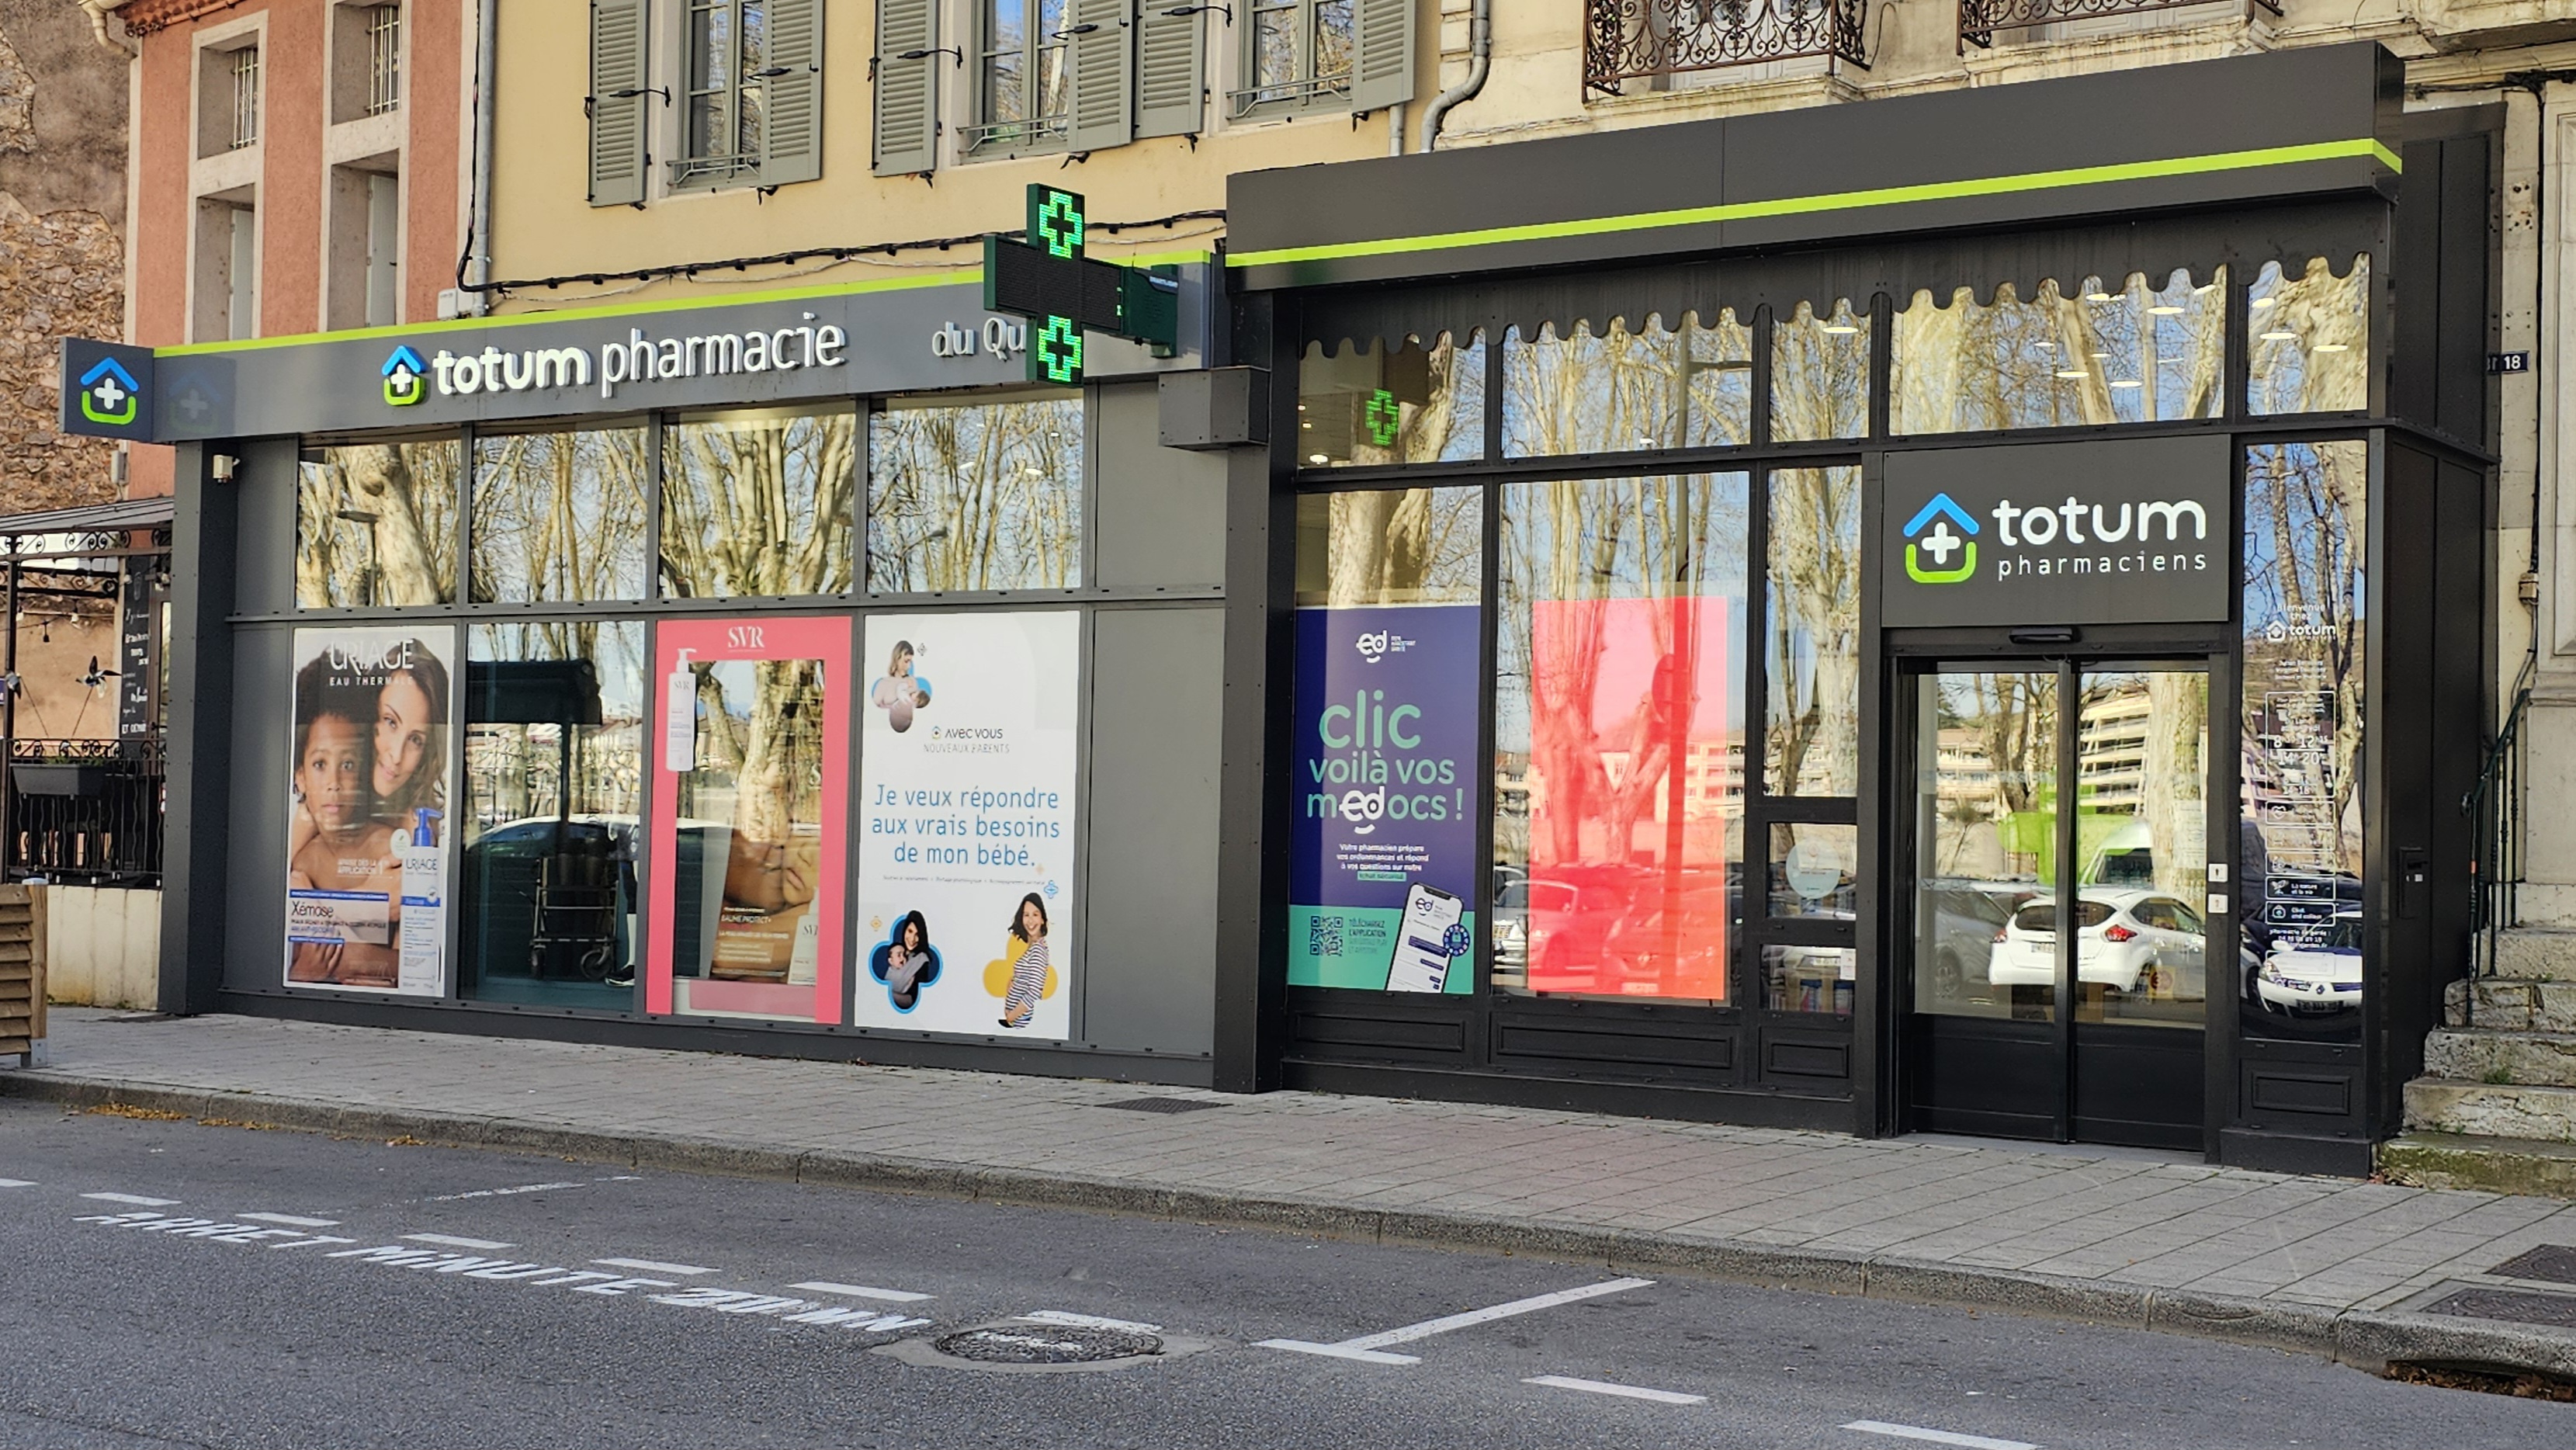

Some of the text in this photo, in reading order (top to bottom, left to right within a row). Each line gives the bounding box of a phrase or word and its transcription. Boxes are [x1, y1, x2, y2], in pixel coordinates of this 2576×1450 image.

[932, 317, 1026, 361] du Qu
[432, 311, 847, 398] totum pharmacie
[2504, 355, 2521, 369] 18
[1992, 496, 2207, 546] totum
[1997, 550, 2207, 581] pharmaciens
[727, 626, 765, 648] SVR
[2289, 624, 2336, 636] totum
[330, 639, 414, 676] URIAGE
[330, 677, 350, 686] EAU
[975, 728, 1004, 739] VOUS
[1319, 689, 1421, 749] clic
[924, 743, 1011, 754] NOUVEAUX PARENTS
[1309, 750, 1455, 785] voilà vos
[874, 784, 1059, 814] Je veux répondre
[872, 813, 1061, 838] aux vrais besoins
[893, 841, 1035, 867] de mon bébé.
[71, 1212, 358, 1249] ARRET
